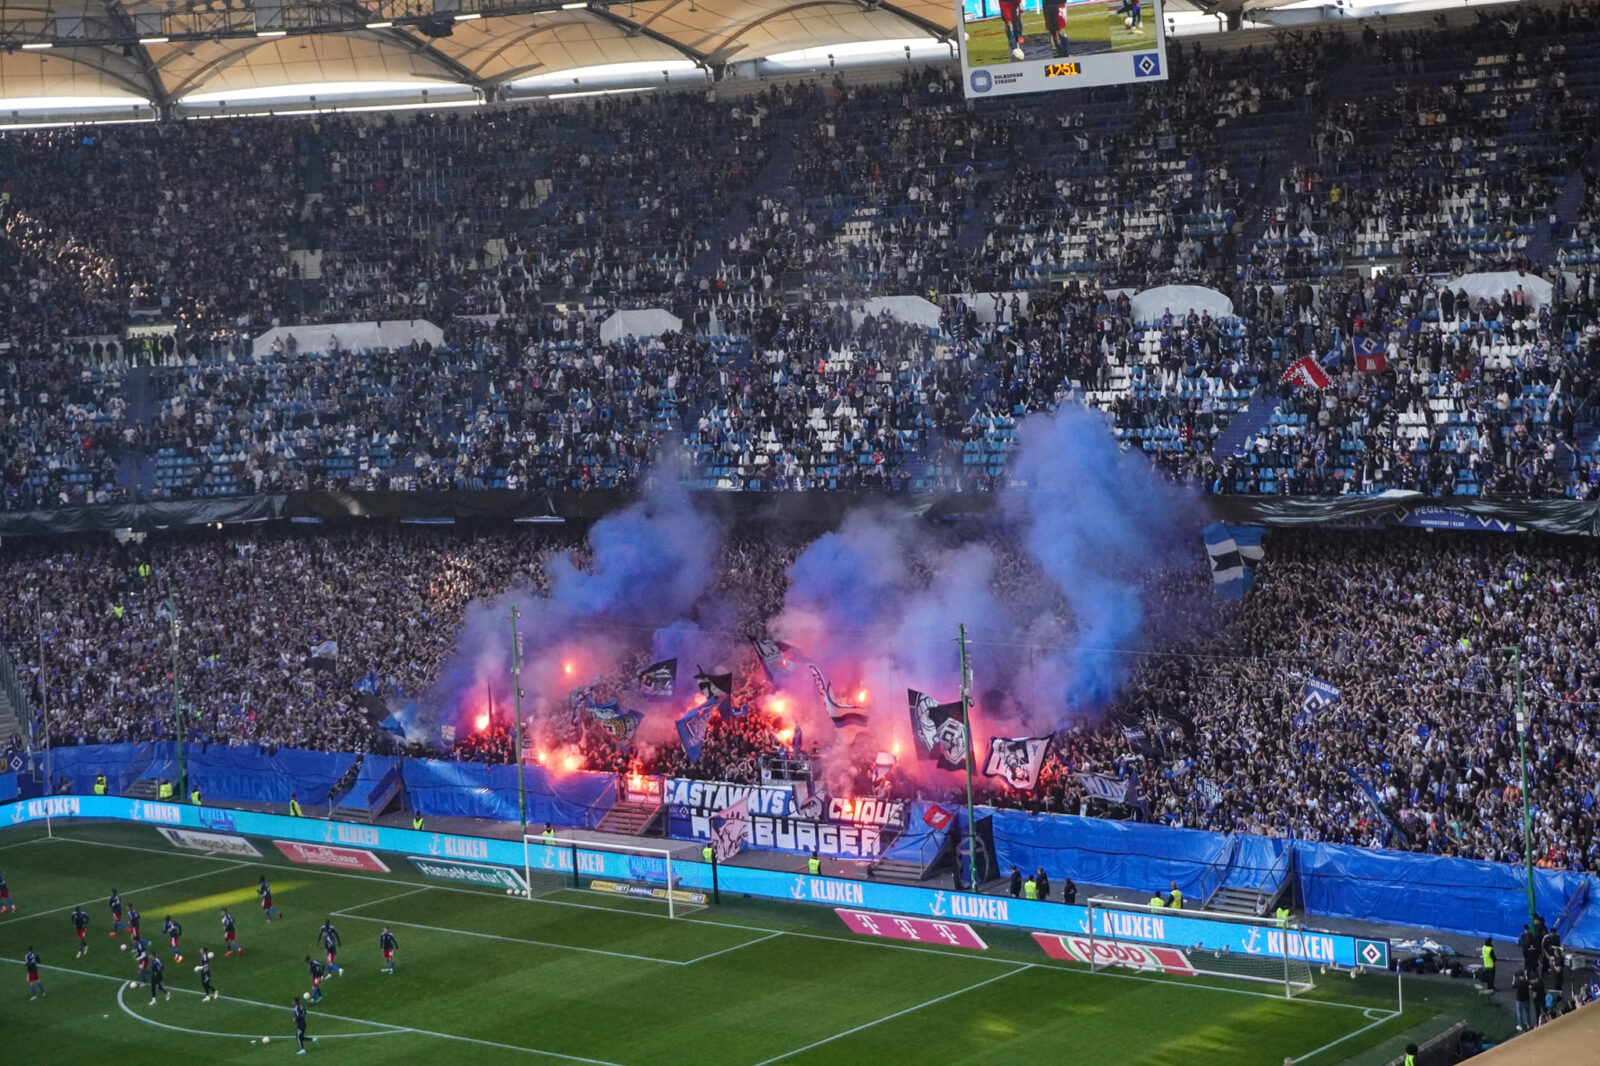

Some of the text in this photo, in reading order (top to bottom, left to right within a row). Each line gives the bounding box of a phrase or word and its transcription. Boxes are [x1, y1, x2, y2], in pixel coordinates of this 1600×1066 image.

[28, 797, 81, 818] KLUXEN
[664, 779, 786, 816] CASTAWAYS
[143, 803, 181, 823] KLUXEN
[829, 797, 905, 827] CLIQUE
[337, 825, 380, 847] KLUXEN
[691, 809, 880, 857] HBURGER
[444, 837, 489, 860] KLUXEN
[416, 862, 502, 885] HanseMerkur
[810, 878, 864, 904] KLUXEN
[951, 894, 1009, 921] KLUXEN
[855, 913, 961, 946] T T T
[1102, 911, 1165, 940] KLUXEN
[1267, 931, 1334, 961] KLUXEN
